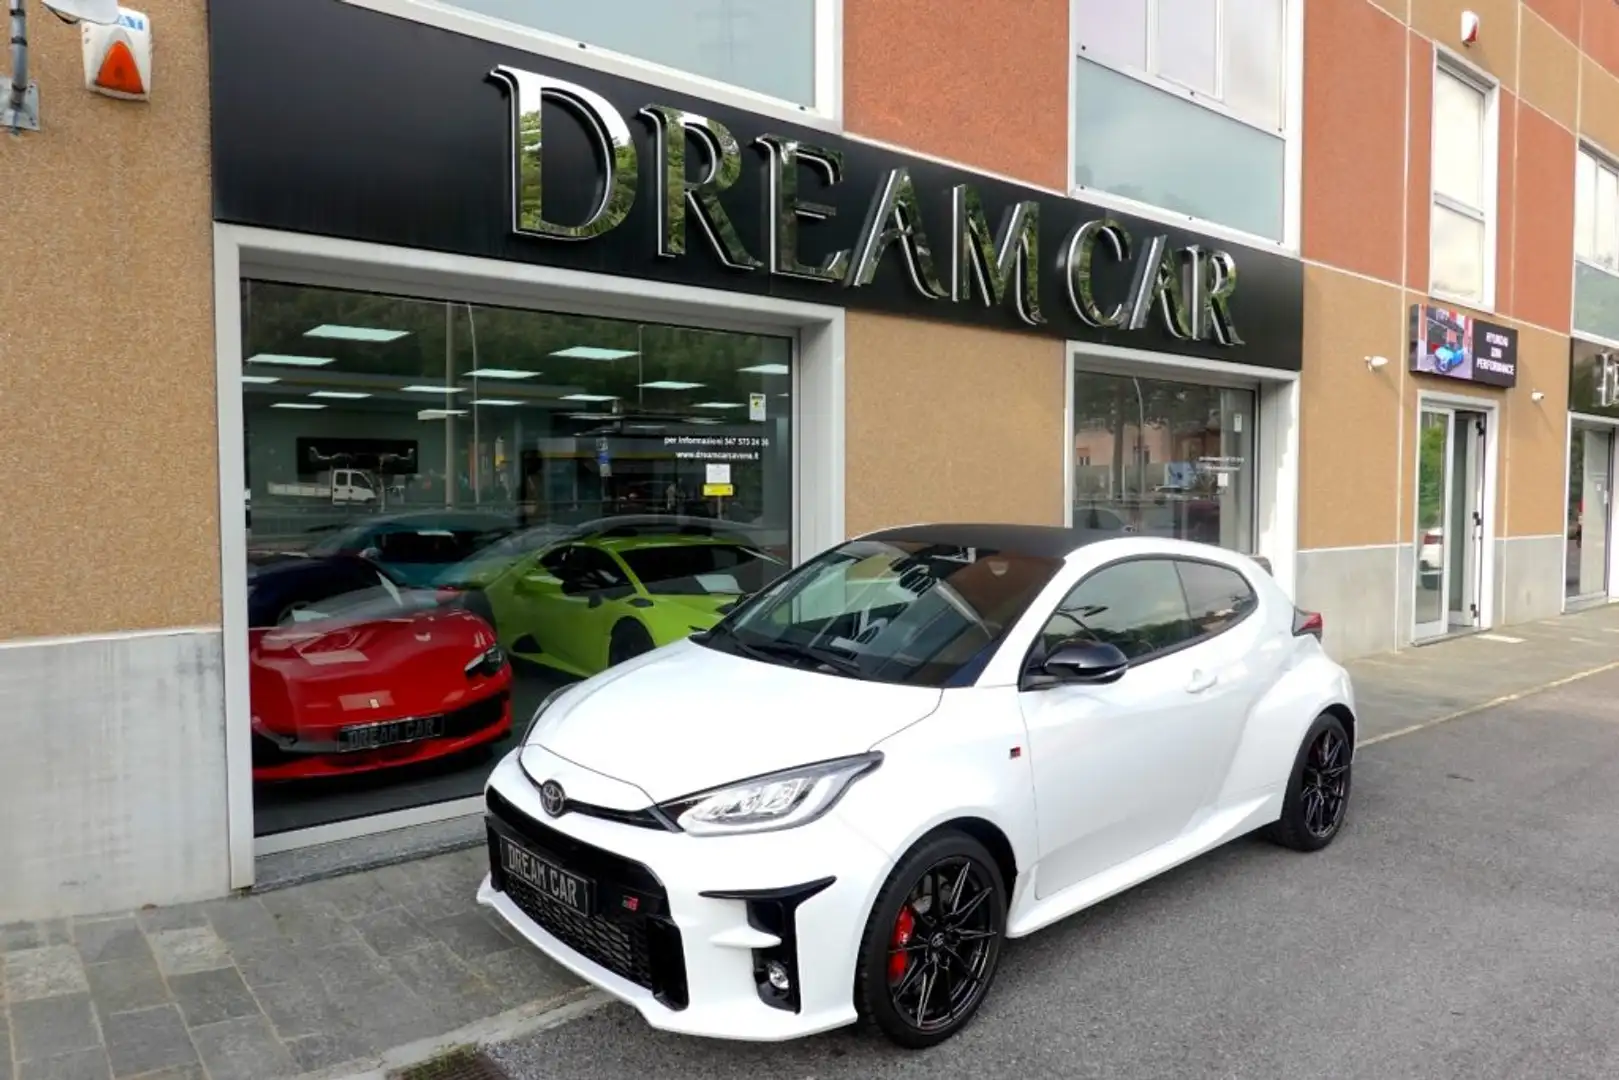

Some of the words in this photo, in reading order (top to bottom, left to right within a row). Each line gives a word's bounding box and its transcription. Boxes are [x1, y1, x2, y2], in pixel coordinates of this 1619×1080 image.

[490, 64, 1046, 326] DREAM
[1056, 216, 1246, 347] CAR
[1476, 356, 1515, 376] PERFORMANCE
[664, 437, 677, 446] per
[347, 725, 399, 748] DREAM
[405, 719, 436, 738] CAR
[507, 843, 547, 890] DREAM
[550, 870, 578, 908] CAR
